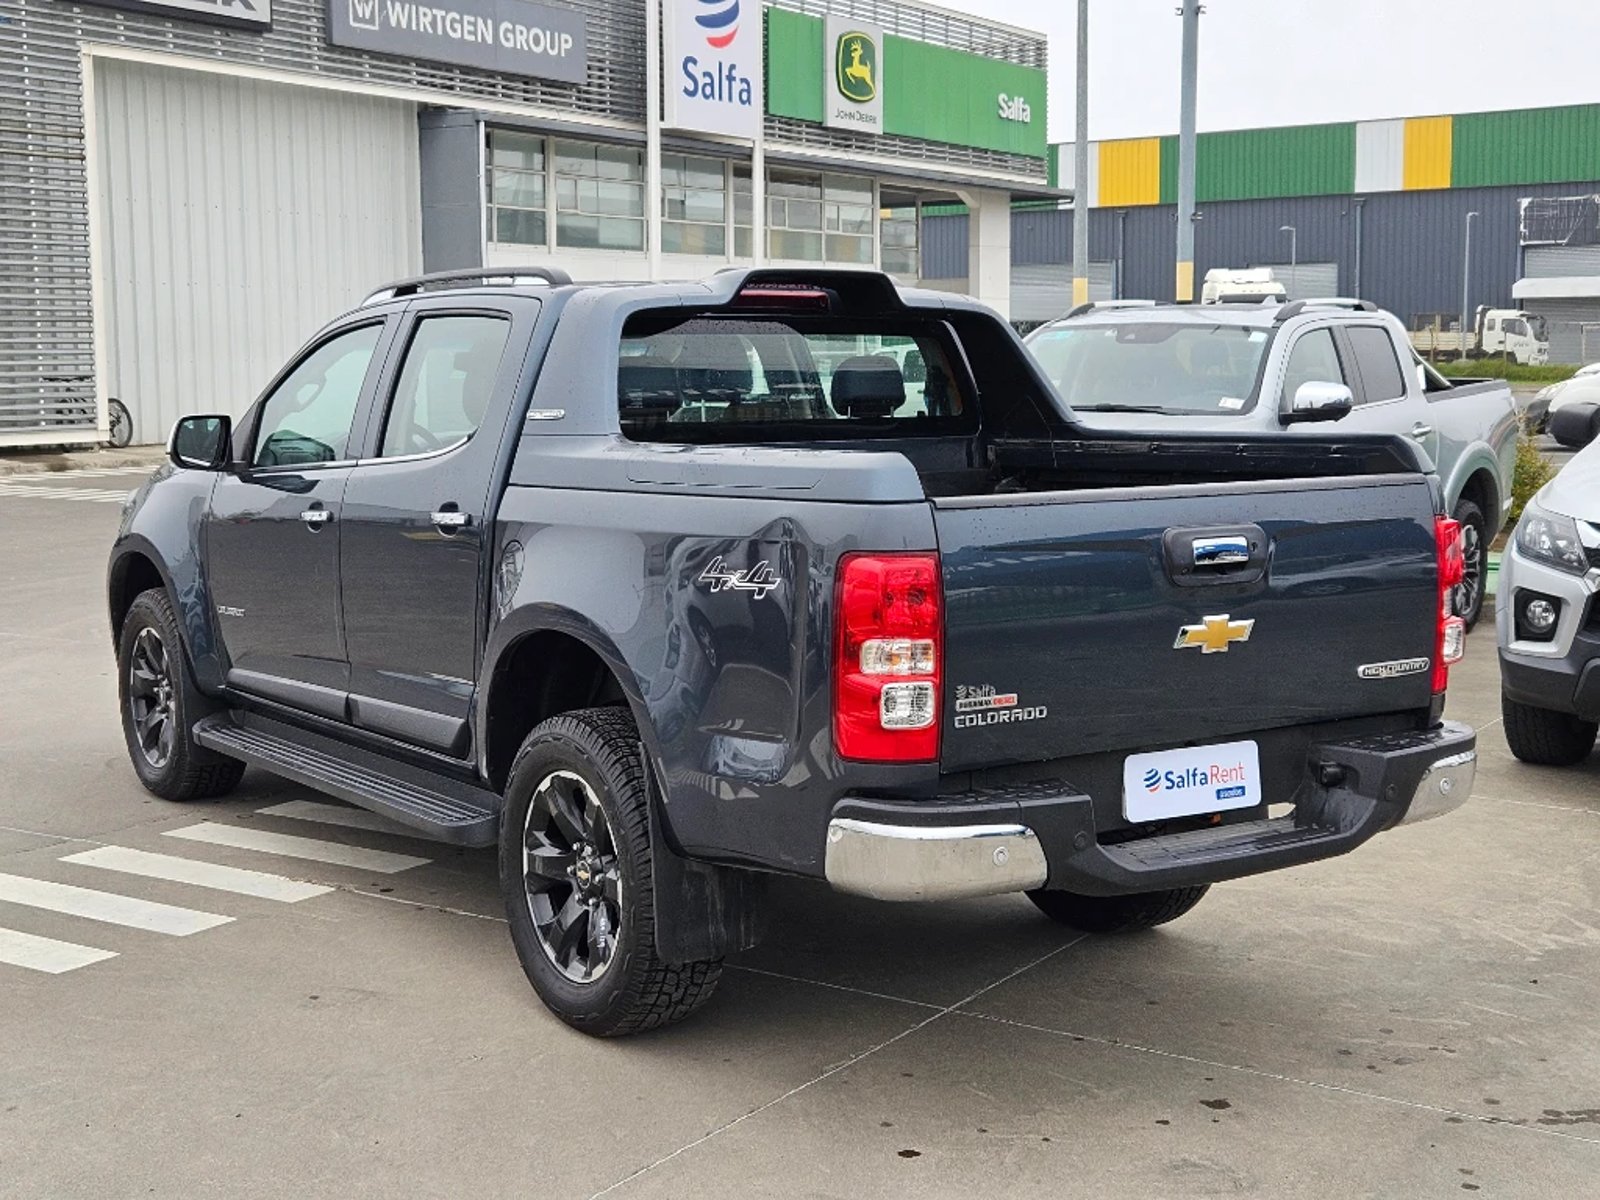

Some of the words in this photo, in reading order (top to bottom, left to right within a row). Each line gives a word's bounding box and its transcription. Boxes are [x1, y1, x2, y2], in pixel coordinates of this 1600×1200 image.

[386, 0, 494, 44] WIRTGEN
[500, 21, 573, 57] GROUP
[682, 55, 752, 106] Salfa
[834, 108, 856, 121] JOHN
[998, 93, 1031, 123] Salfa
[1365, 666, 1386, 676] HIGH
[1387, 661, 1427, 675] COUNTRY
[953, 705, 1048, 729] COLORADO
